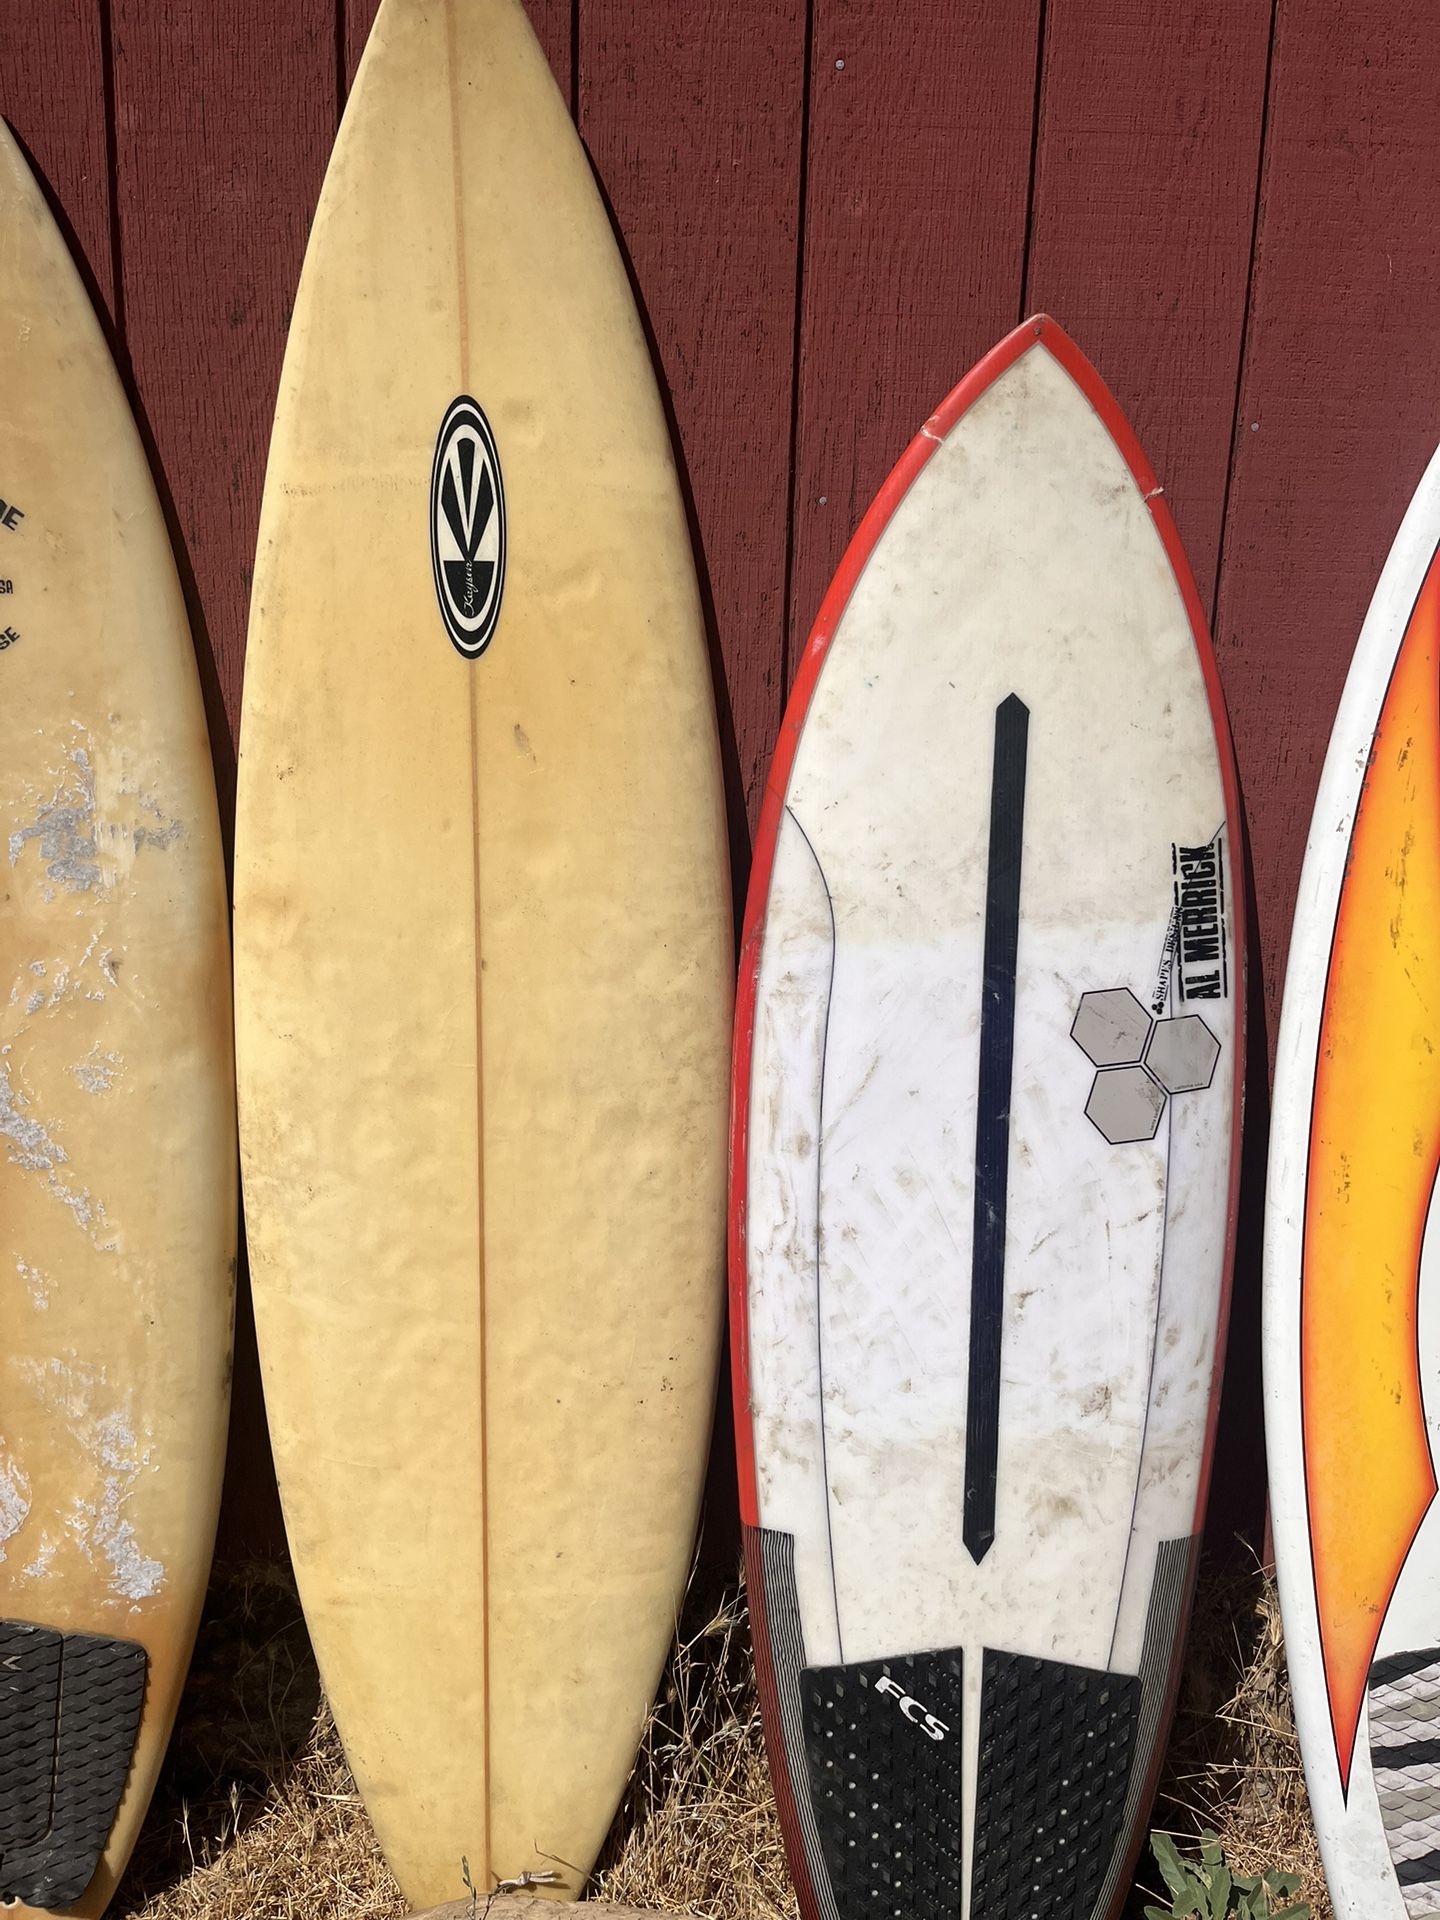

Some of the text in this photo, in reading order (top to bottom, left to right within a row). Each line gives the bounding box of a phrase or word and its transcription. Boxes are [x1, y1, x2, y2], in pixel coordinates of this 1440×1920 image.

[1179, 842, 1221, 1000] AL MERRICK
[874, 1675, 950, 1740] FCS
